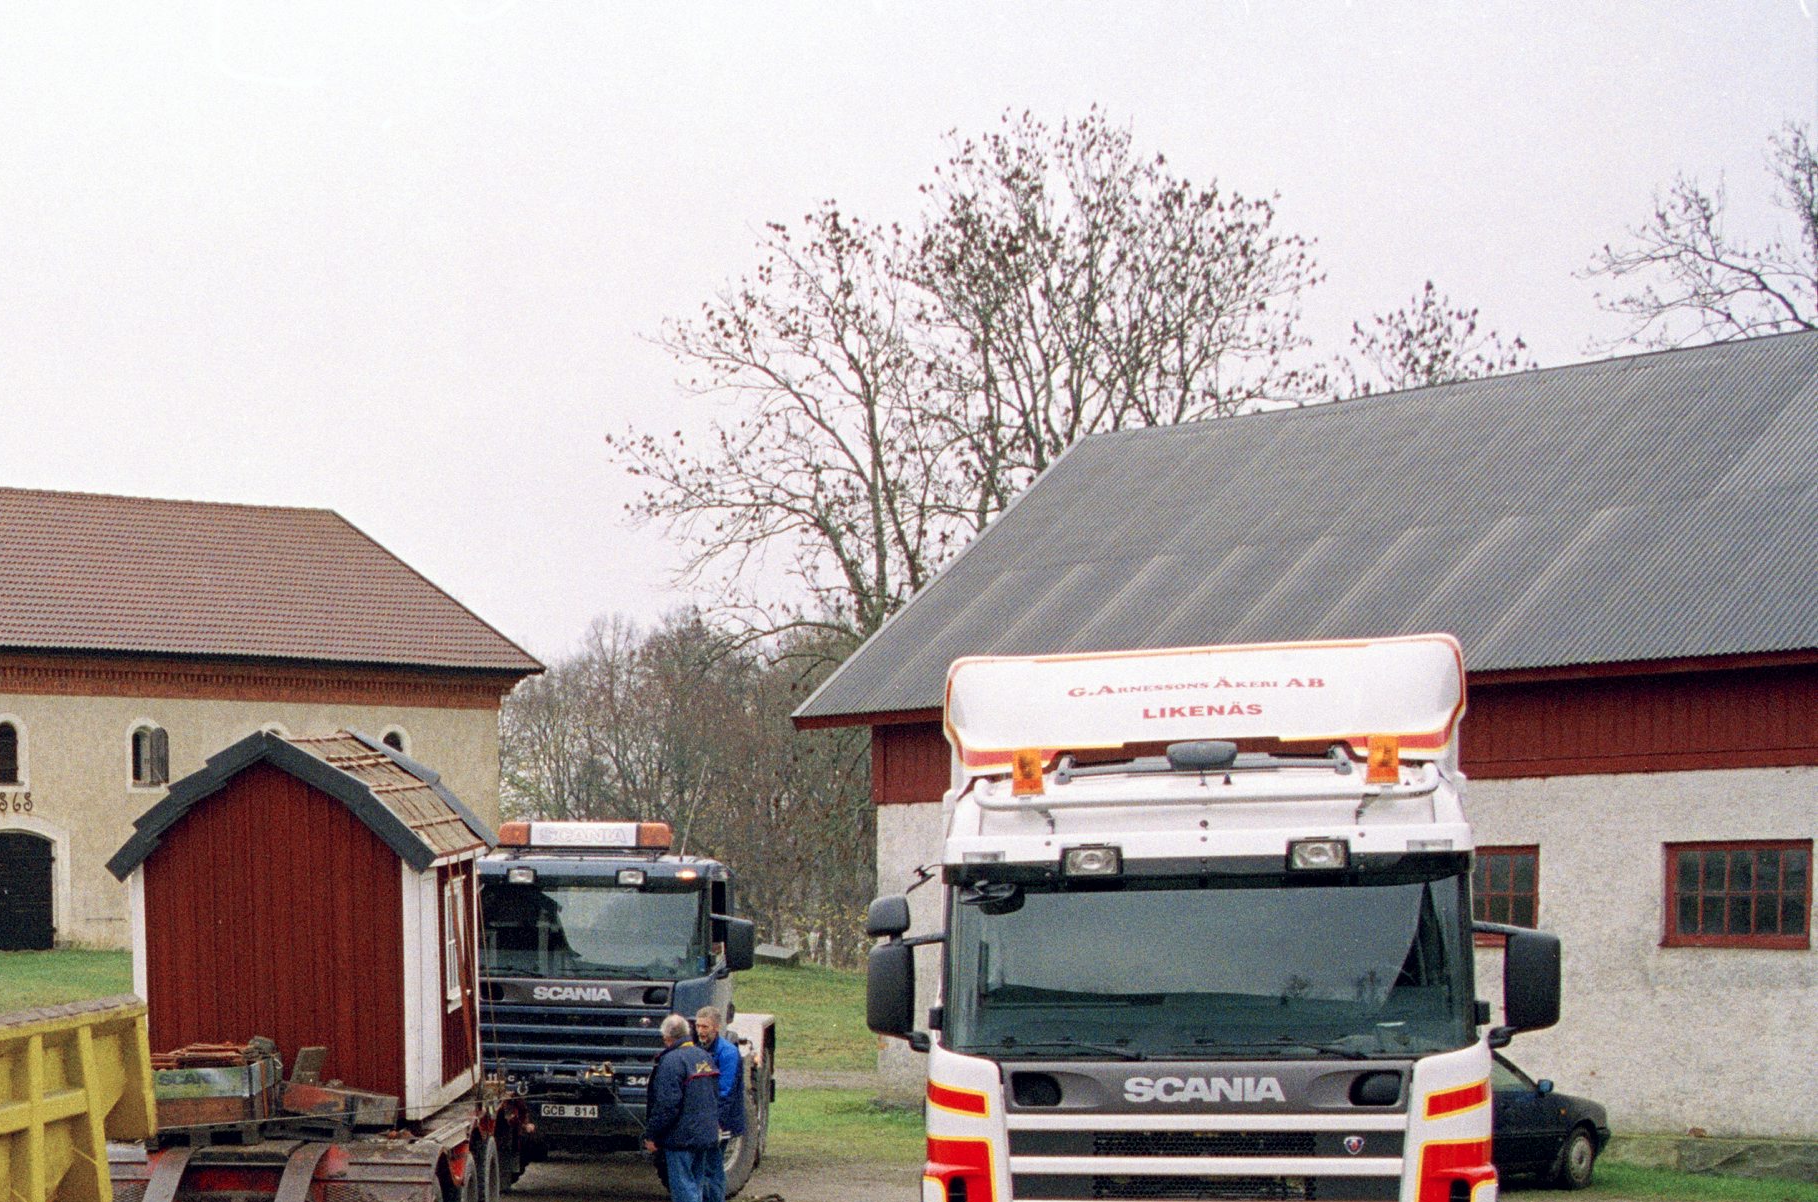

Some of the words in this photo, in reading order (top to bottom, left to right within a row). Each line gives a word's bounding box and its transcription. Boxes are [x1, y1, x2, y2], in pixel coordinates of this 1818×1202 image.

[1286, 677, 1325, 688] AB
[1142, 701, 1263, 719] LIKENÄS
[539, 826, 628, 844] SCANIA
[533, 986, 613, 1001] SCANIA
[1123, 1076, 1286, 1103] SCANIA
[542, 1106, 566, 1115] GCB
[574, 1107, 597, 1117] 814
